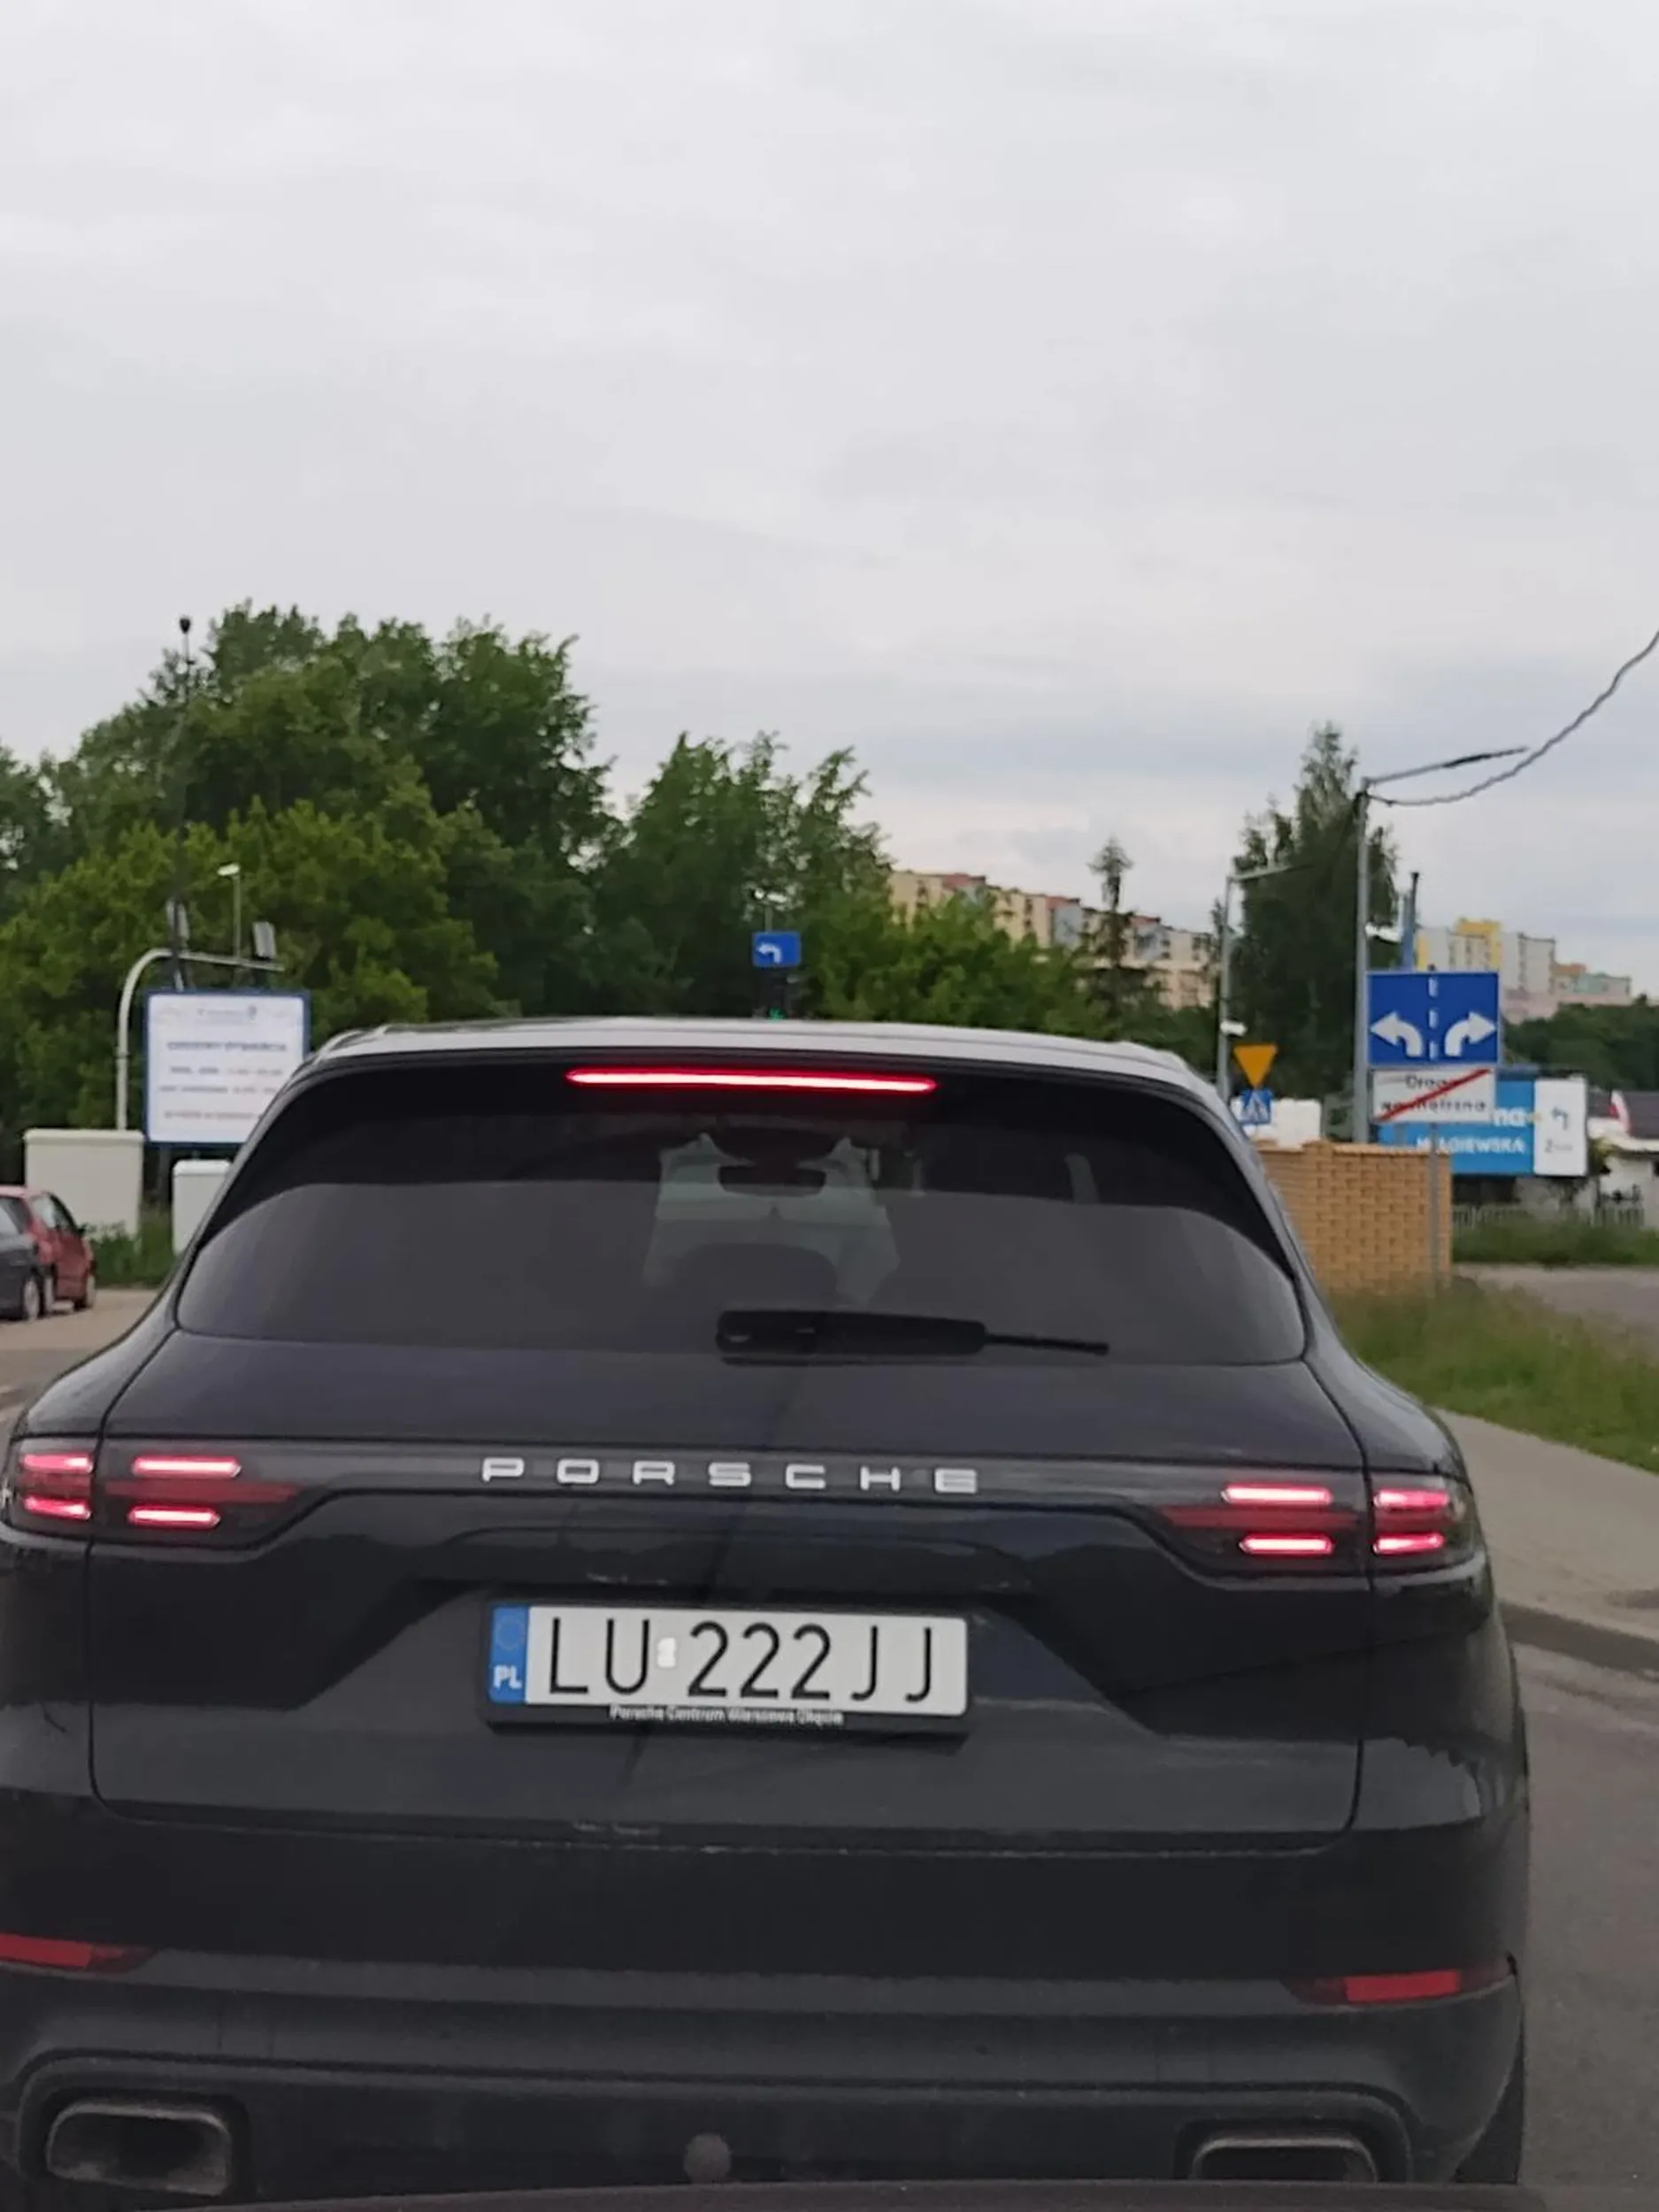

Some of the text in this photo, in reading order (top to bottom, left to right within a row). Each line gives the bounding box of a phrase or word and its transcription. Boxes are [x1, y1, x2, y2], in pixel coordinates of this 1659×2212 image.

[481, 1456, 978, 1494] PORSCHE
[493, 1664, 523, 1689] PL
[549, 1617, 932, 1703] LU 222JJ
